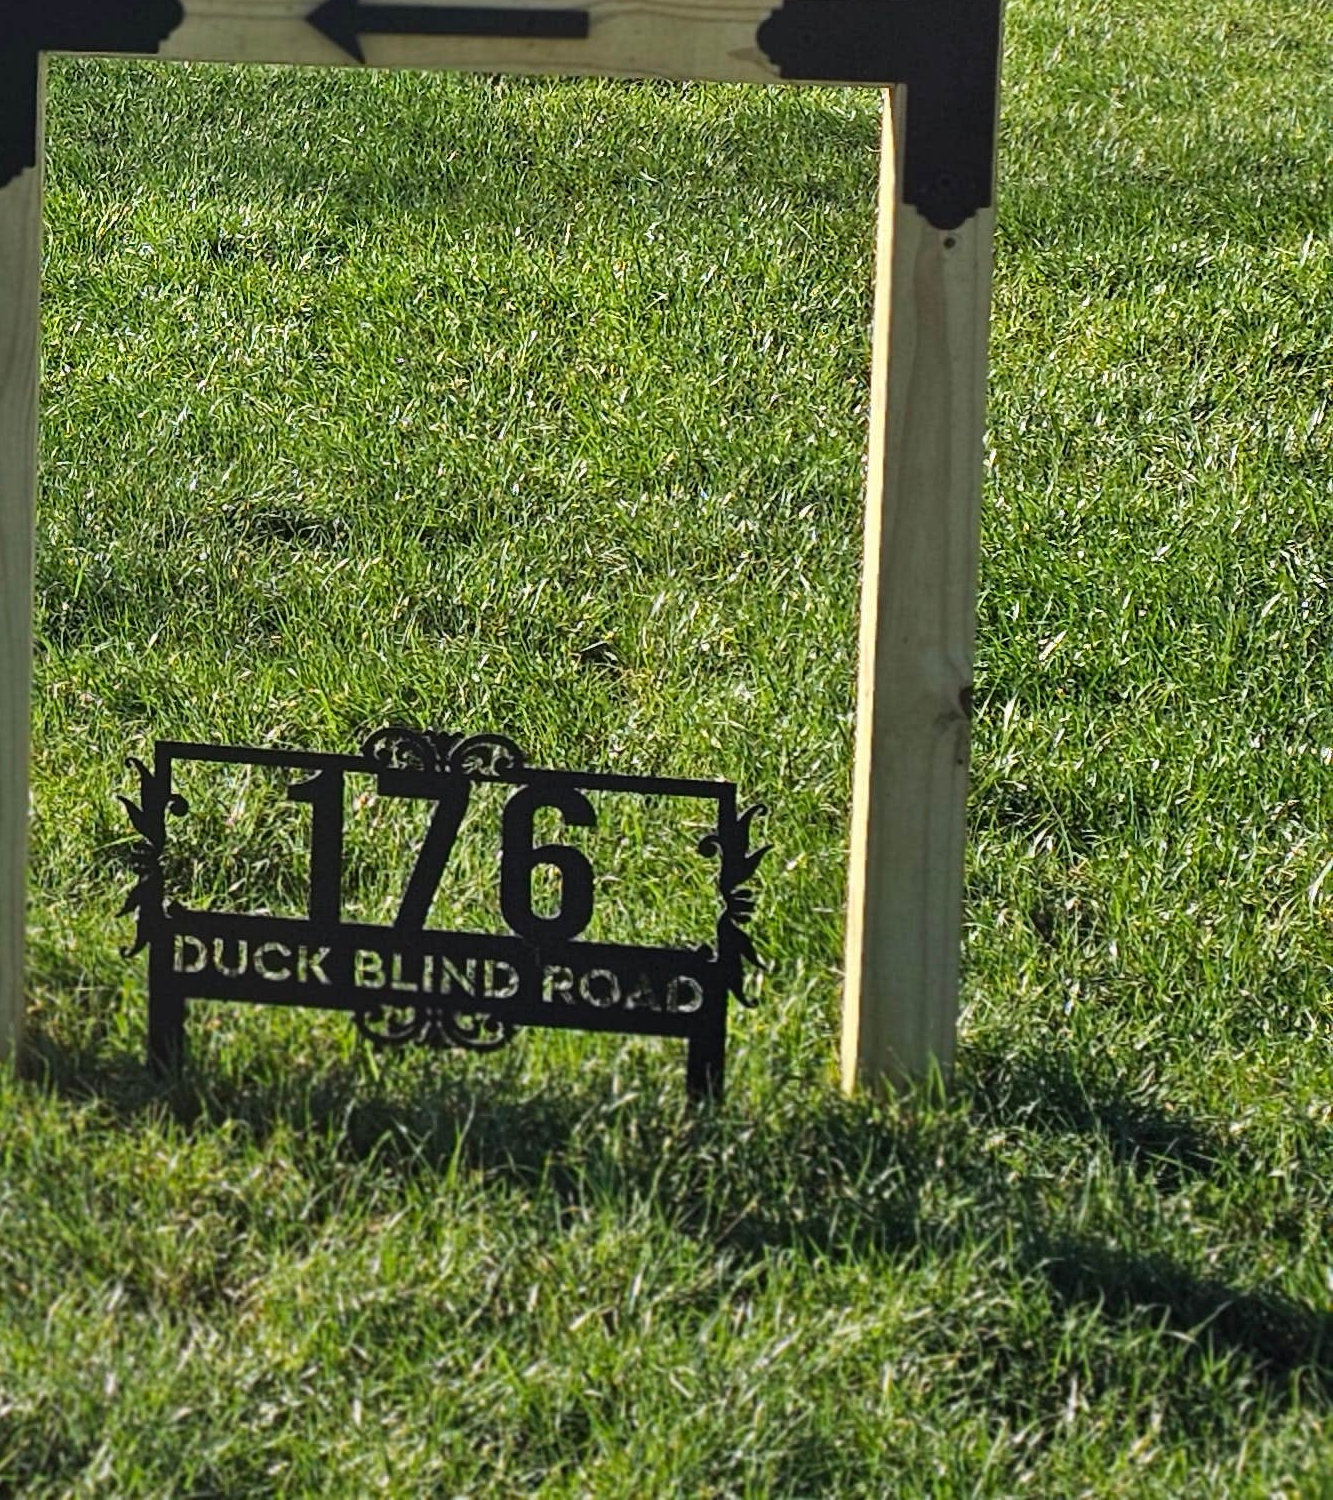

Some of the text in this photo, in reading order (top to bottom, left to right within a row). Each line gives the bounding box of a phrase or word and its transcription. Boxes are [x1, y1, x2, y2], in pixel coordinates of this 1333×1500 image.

[287, 768, 597, 942] 176
[172, 933, 704, 1015] DUCK BLIND ROAD
